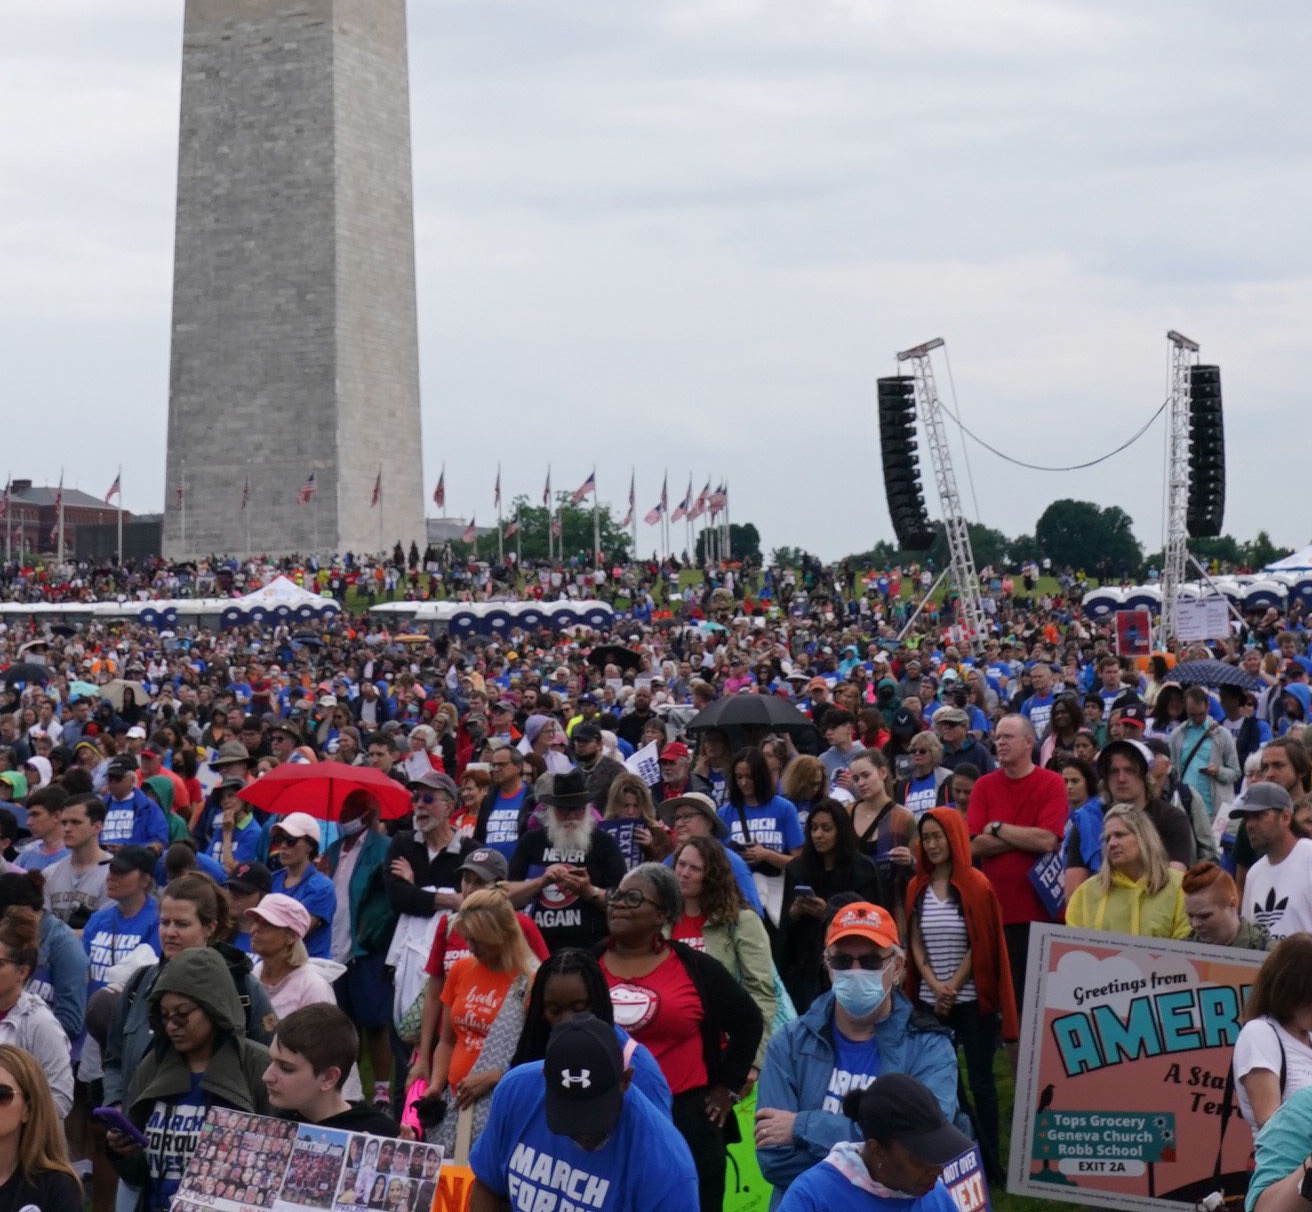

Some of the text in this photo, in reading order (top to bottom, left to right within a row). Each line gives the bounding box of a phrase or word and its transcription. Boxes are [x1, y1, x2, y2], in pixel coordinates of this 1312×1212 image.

[542, 848, 586, 863] NEVER
[1039, 856, 1062, 888] TEXT
[535, 909, 582, 928] AGAIN
[1073, 971, 1187, 1005] Greetings from
[1163, 1063, 1182, 1083] A
[1054, 1114, 1146, 1129] Tops Grocery
[1047, 1129, 1153, 1143] Geneva Church
[1058, 1144, 1143, 1157] Robb School
[509, 1142, 611, 1209] MARCH
[1078, 1161, 1126, 1173] EXIT 2A
